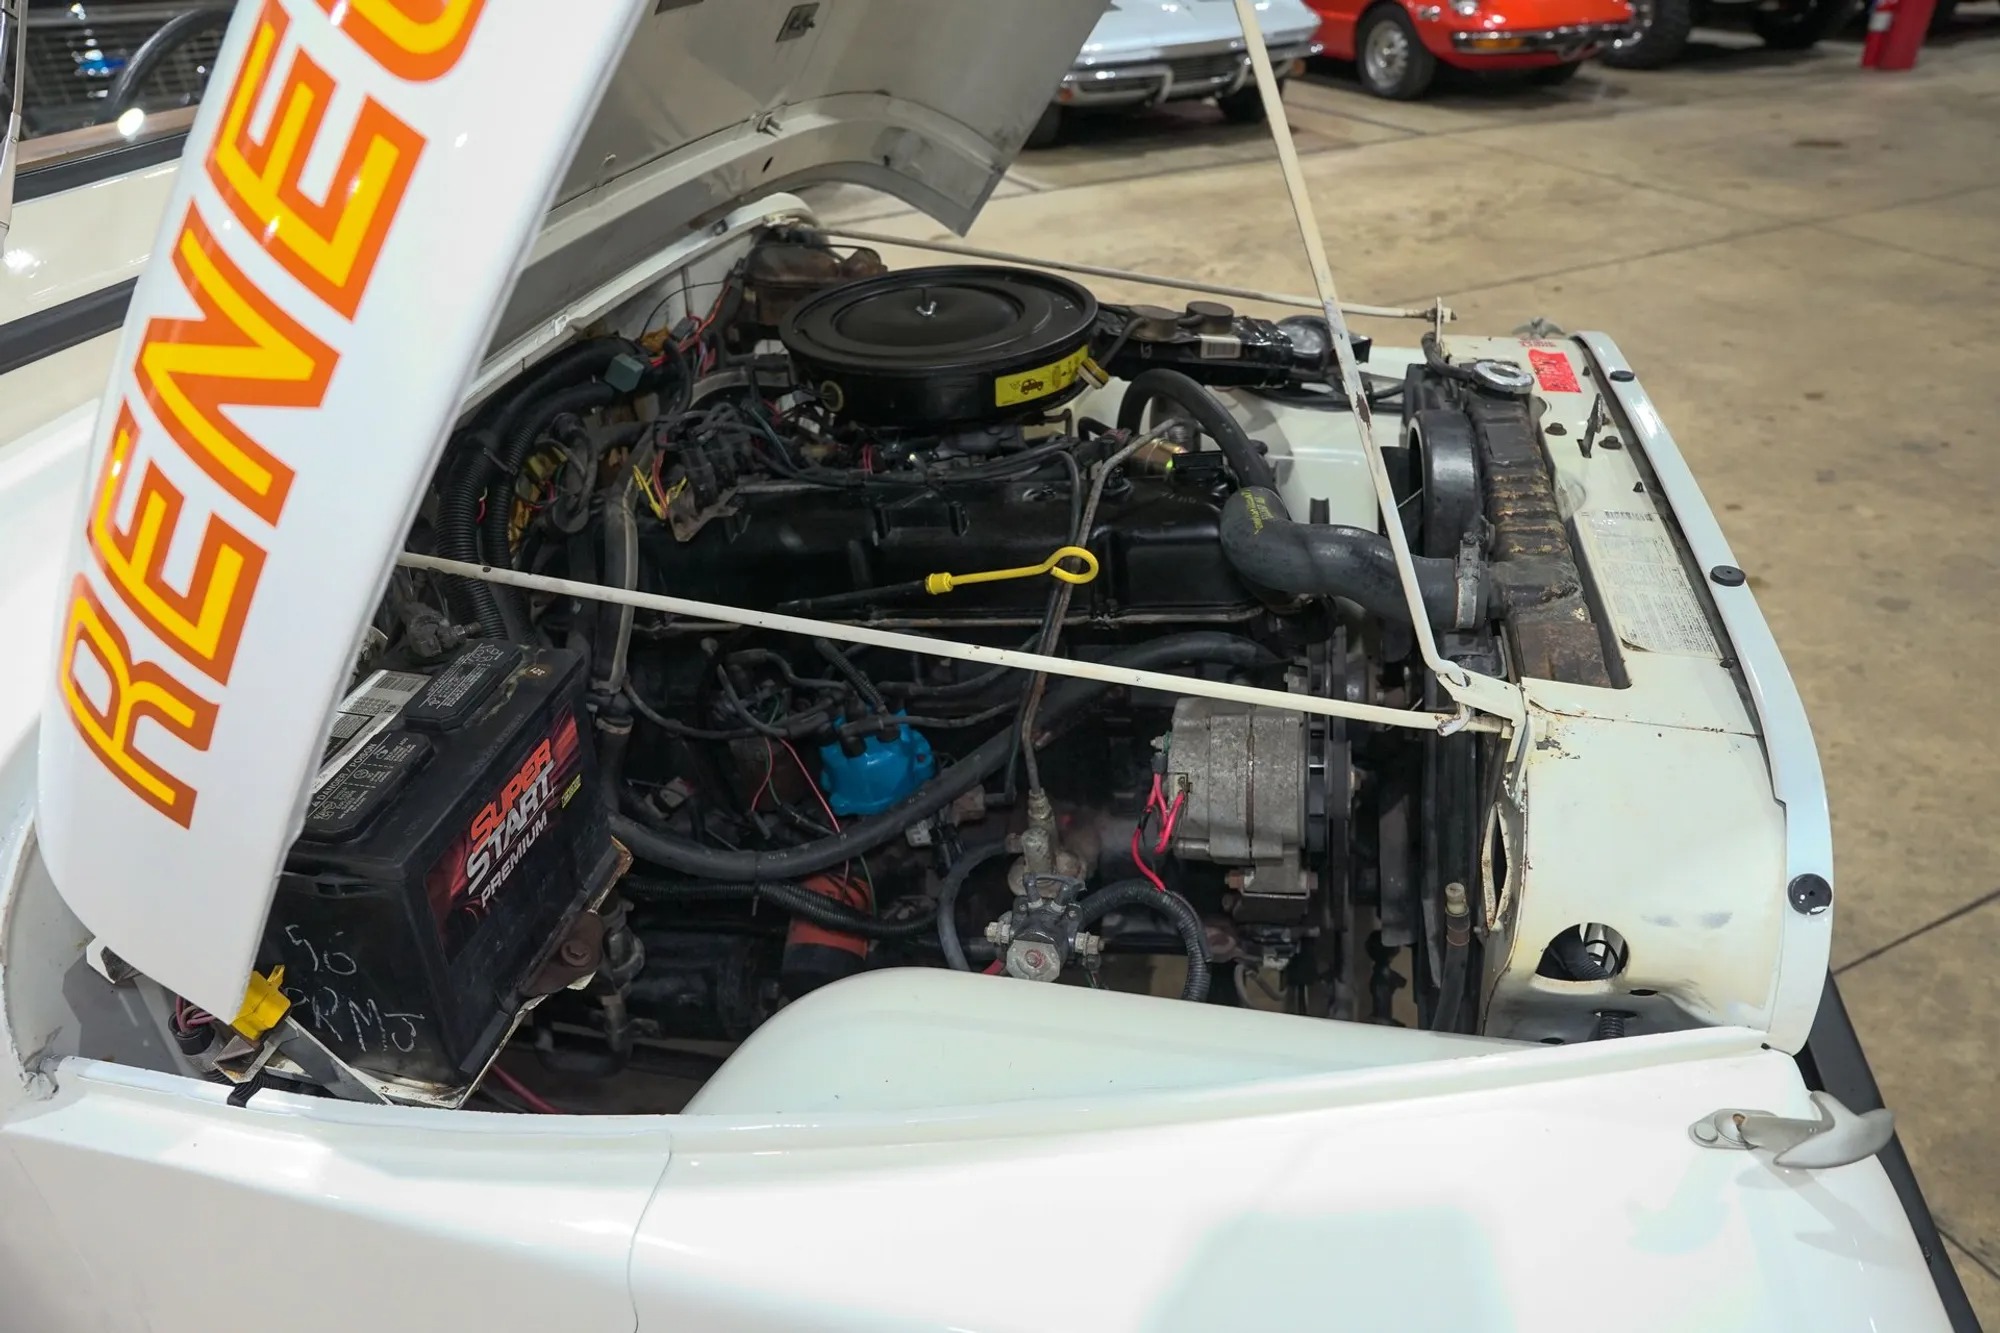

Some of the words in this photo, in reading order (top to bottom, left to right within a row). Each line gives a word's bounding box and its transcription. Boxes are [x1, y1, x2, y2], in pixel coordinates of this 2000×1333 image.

[316, 772, 349, 801] DANGER
[349, 743, 378, 768] POISON
[471, 738, 551, 854] SUPER
[466, 759, 556, 895] START
[480, 811, 548, 908] PREMIUM
